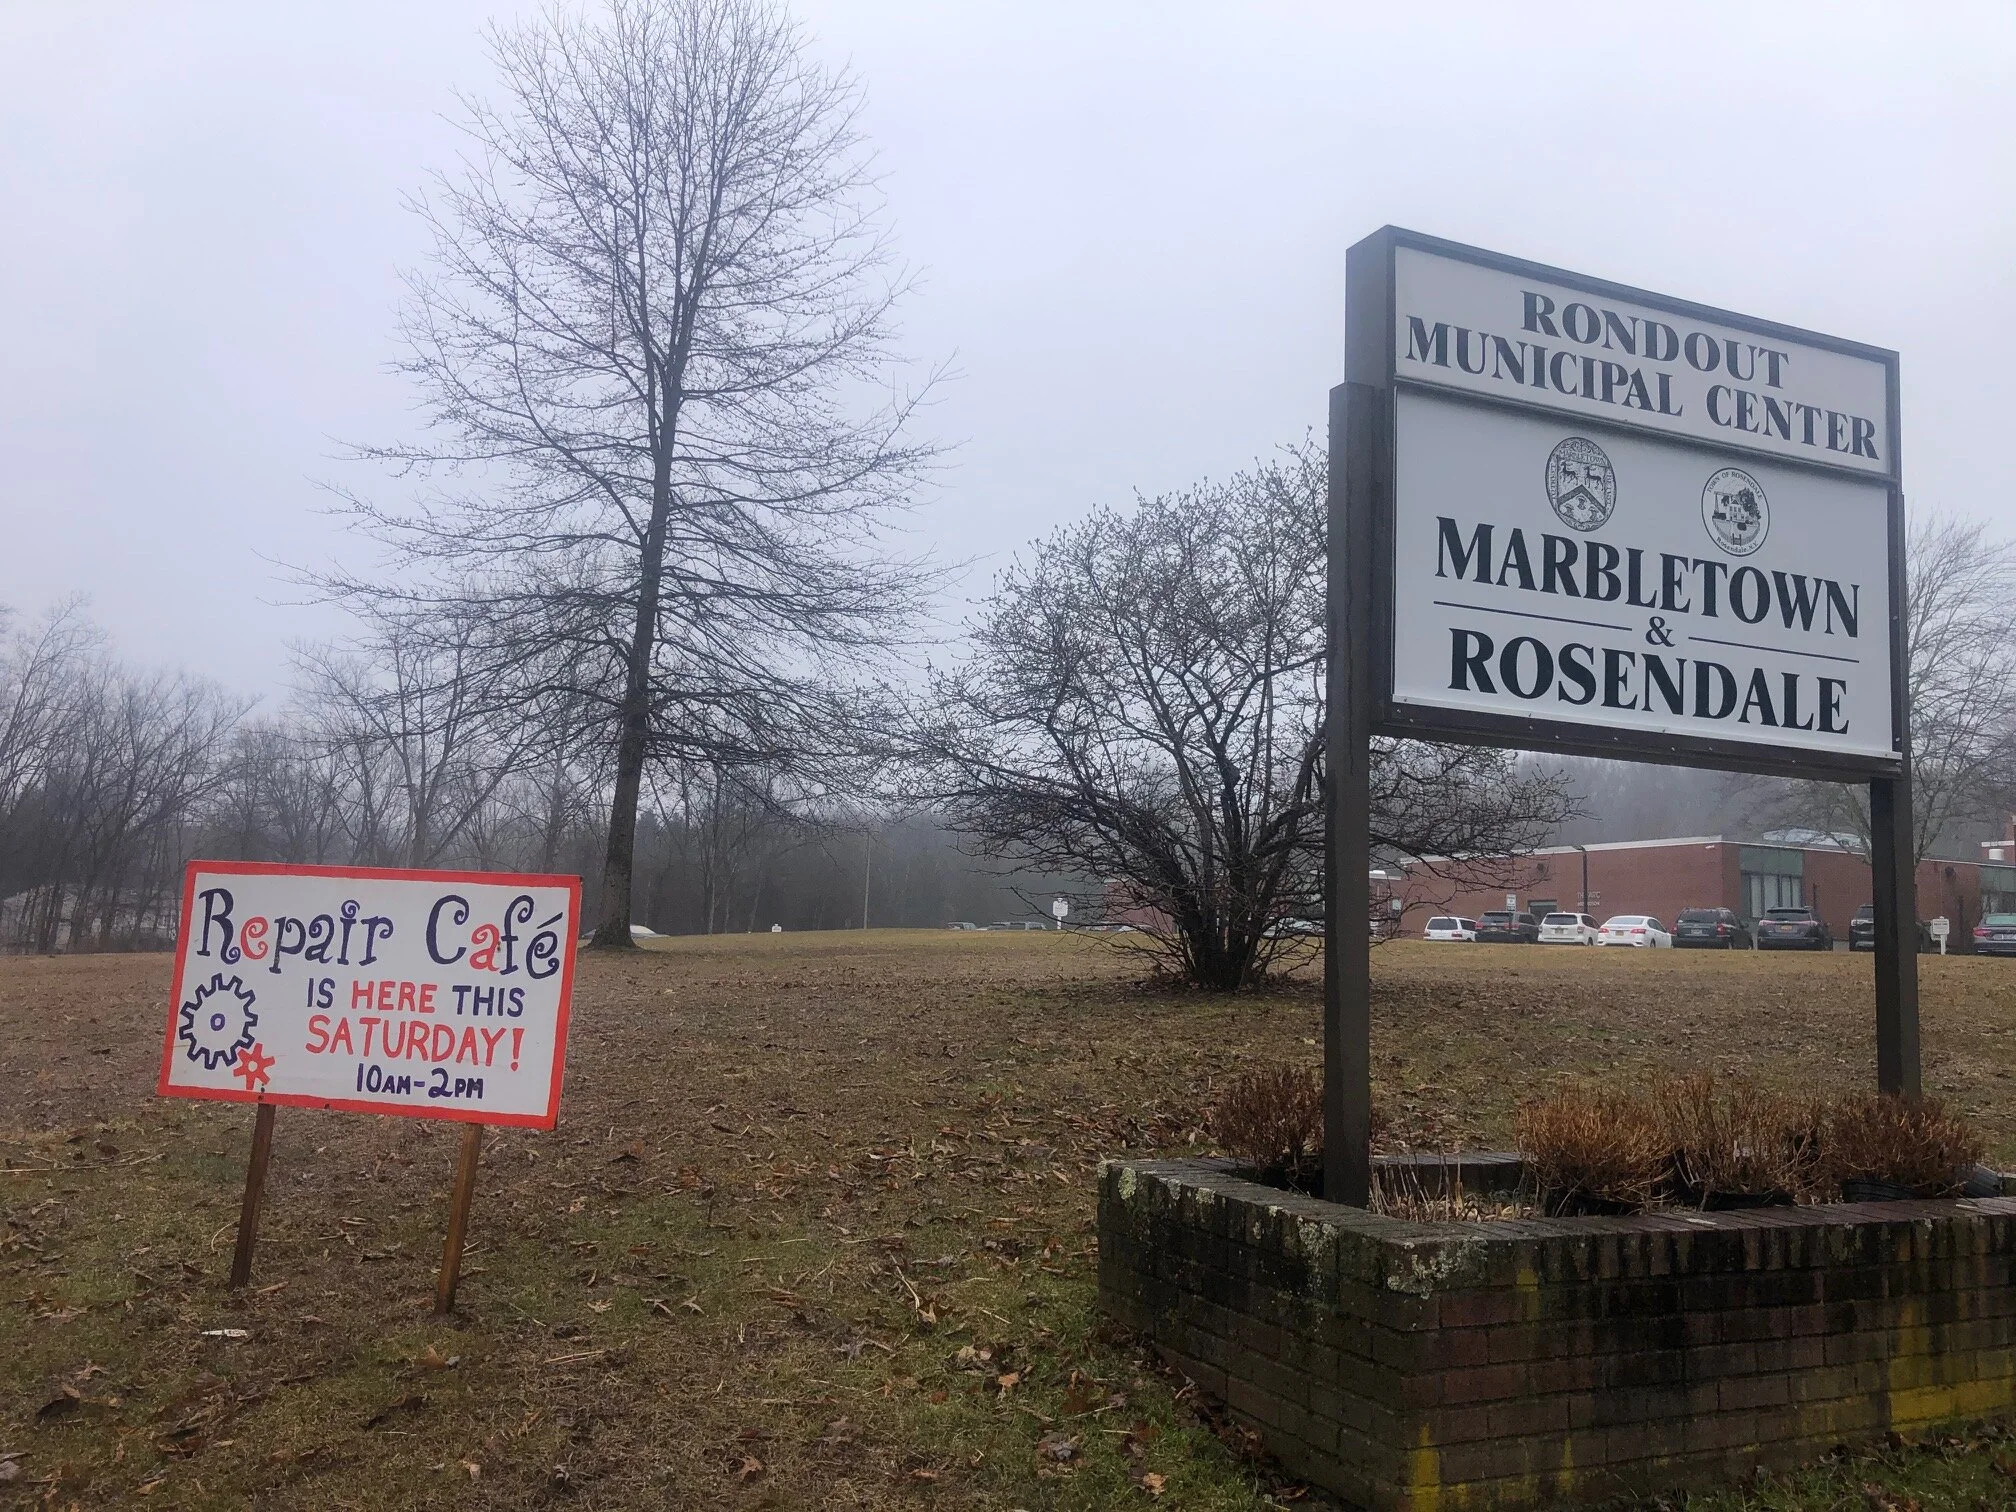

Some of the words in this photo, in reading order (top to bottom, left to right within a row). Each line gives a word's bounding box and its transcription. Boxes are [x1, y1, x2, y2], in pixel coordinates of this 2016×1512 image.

[1520, 289, 1789, 390] RONDOUT
[1405, 315, 1684, 418] MUNICIPAL
[1706, 384, 1880, 460] CENTER
[1707, 476, 1720, 493] TOWN
[1731, 471, 1762, 499] ROSENDALE
[1434, 516, 1861, 638] MARBLETOWN
[1645, 616, 1675, 648] &
[1448, 627, 1850, 735] ROSENDALE
[197, 887, 393, 974] Repair
[425, 894, 563, 979] Café
[305, 1014, 525, 1072] SATURDAY!
[307, 977, 336, 1008] IS
[351, 980, 439, 1014] HERE
[452, 985, 526, 1017] THIS
